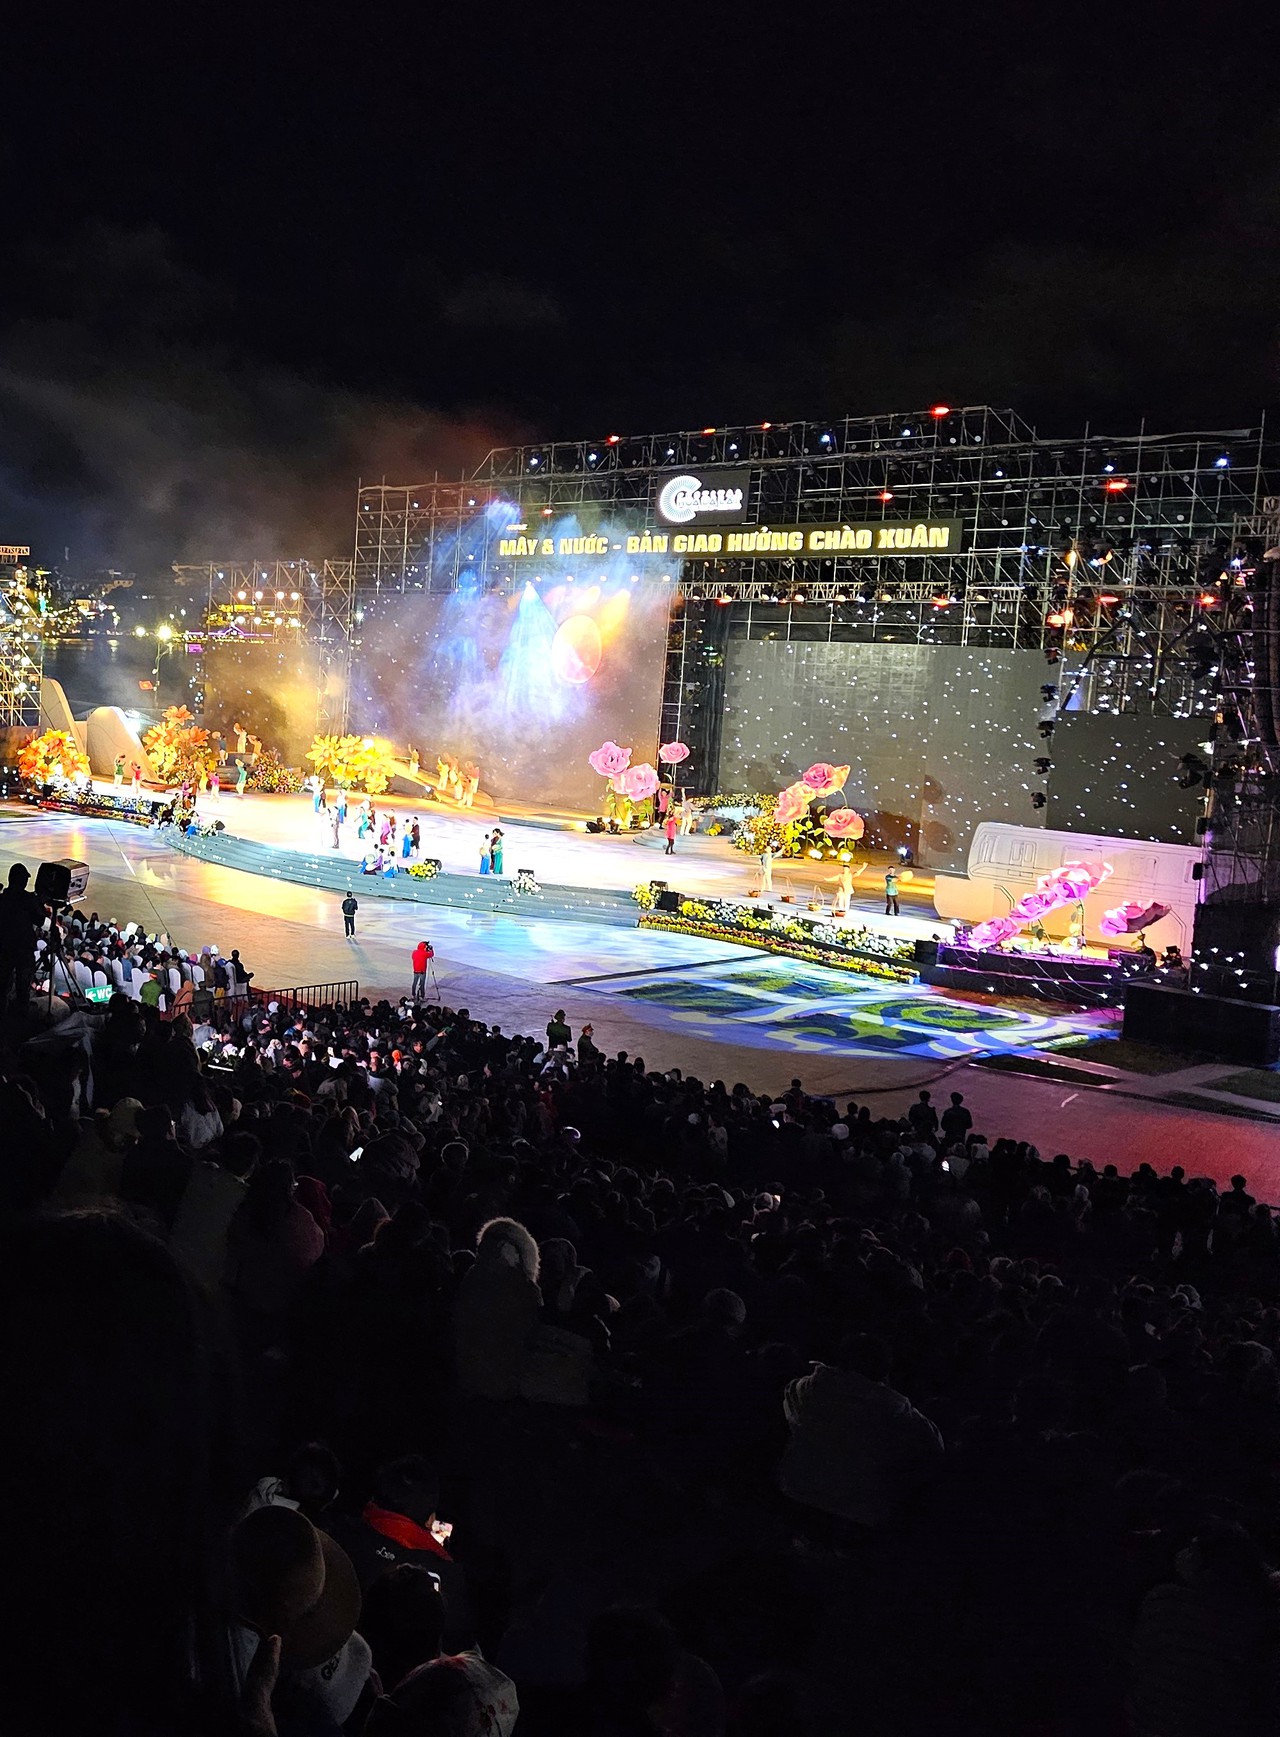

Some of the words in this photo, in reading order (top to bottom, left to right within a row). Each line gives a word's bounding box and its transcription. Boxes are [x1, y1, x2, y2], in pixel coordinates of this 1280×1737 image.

[499, 535, 538, 556] MÂY
[541, 539, 554, 555] &
[558, 533, 609, 555] NƯỚC
[626, 530, 669, 554] BẢN
[673, 533, 723, 553] GIAO
[726, 525, 804, 552] HƯỞNG
[809, 524, 873, 550] CHÀO
[877, 523, 950, 549] XUÂN
[96, 988, 111, 999] WC
